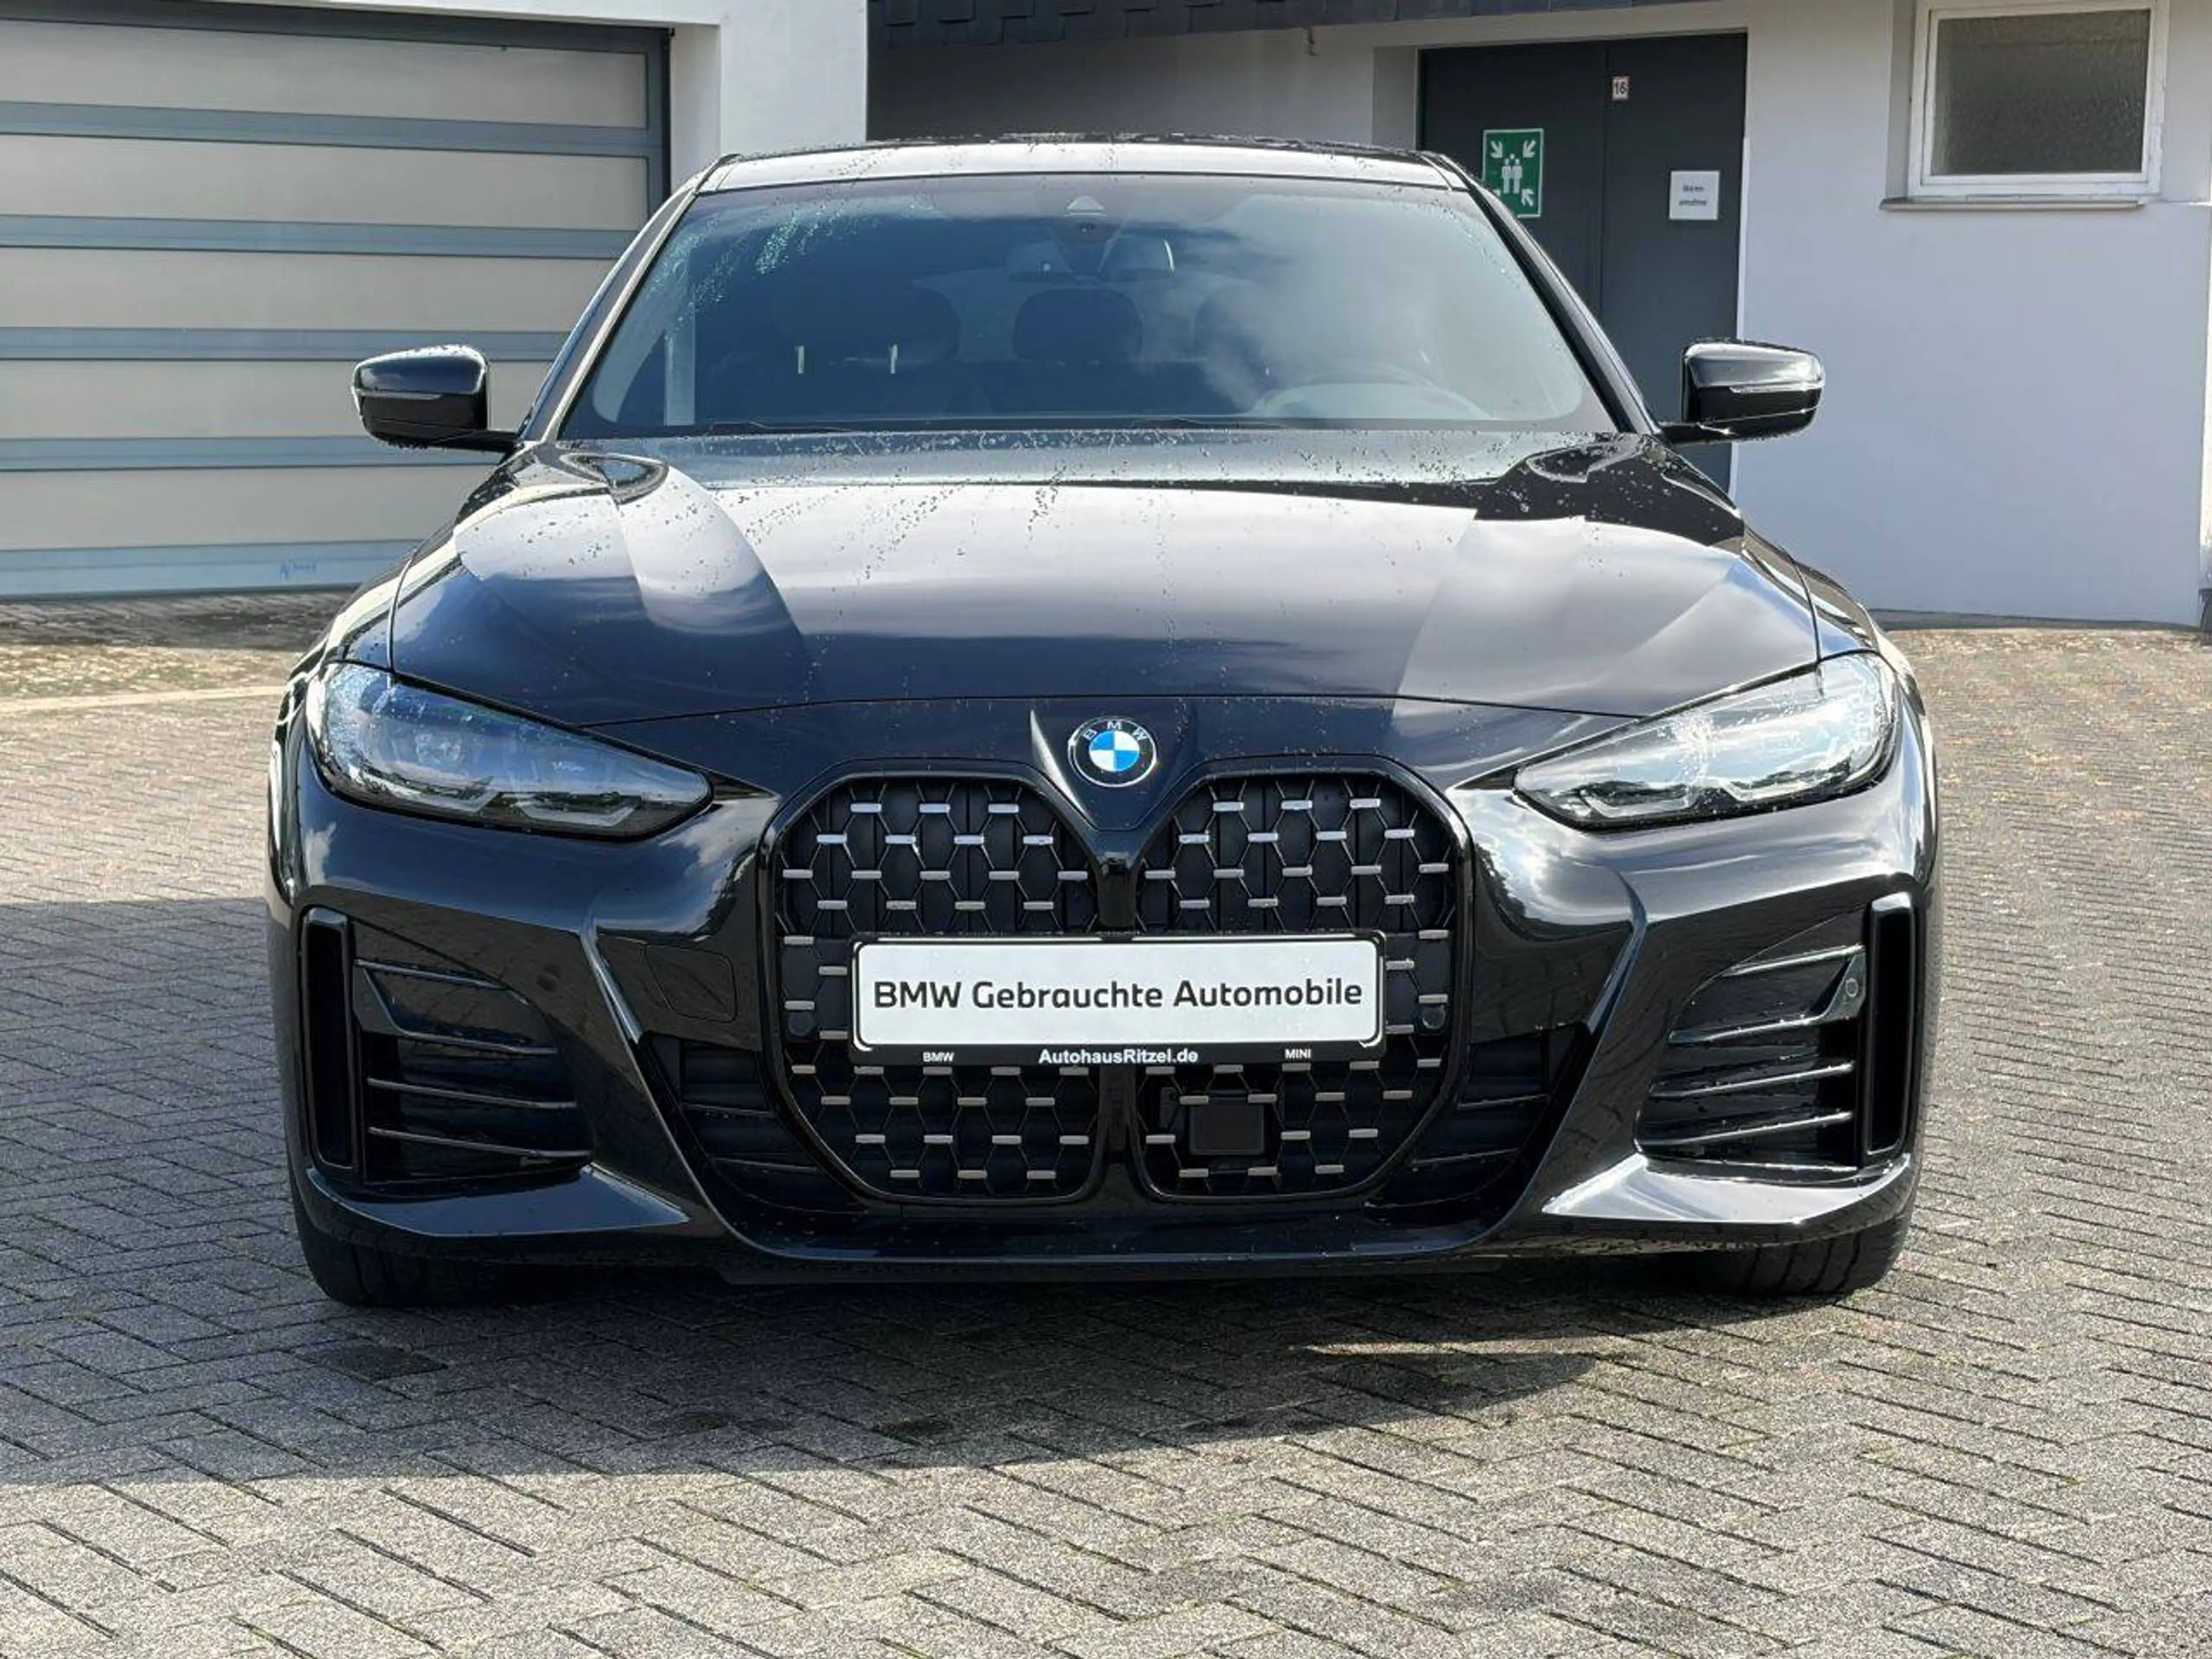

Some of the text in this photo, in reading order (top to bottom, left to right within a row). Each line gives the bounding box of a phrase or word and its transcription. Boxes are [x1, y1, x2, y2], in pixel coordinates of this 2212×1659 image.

[1082, 721, 1148, 741] BMW
[874, 978, 1363, 1009] BMW Gebrauchte Automobile
[923, 1048, 1312, 1064] BMW AutohausRitzel.de MINI
